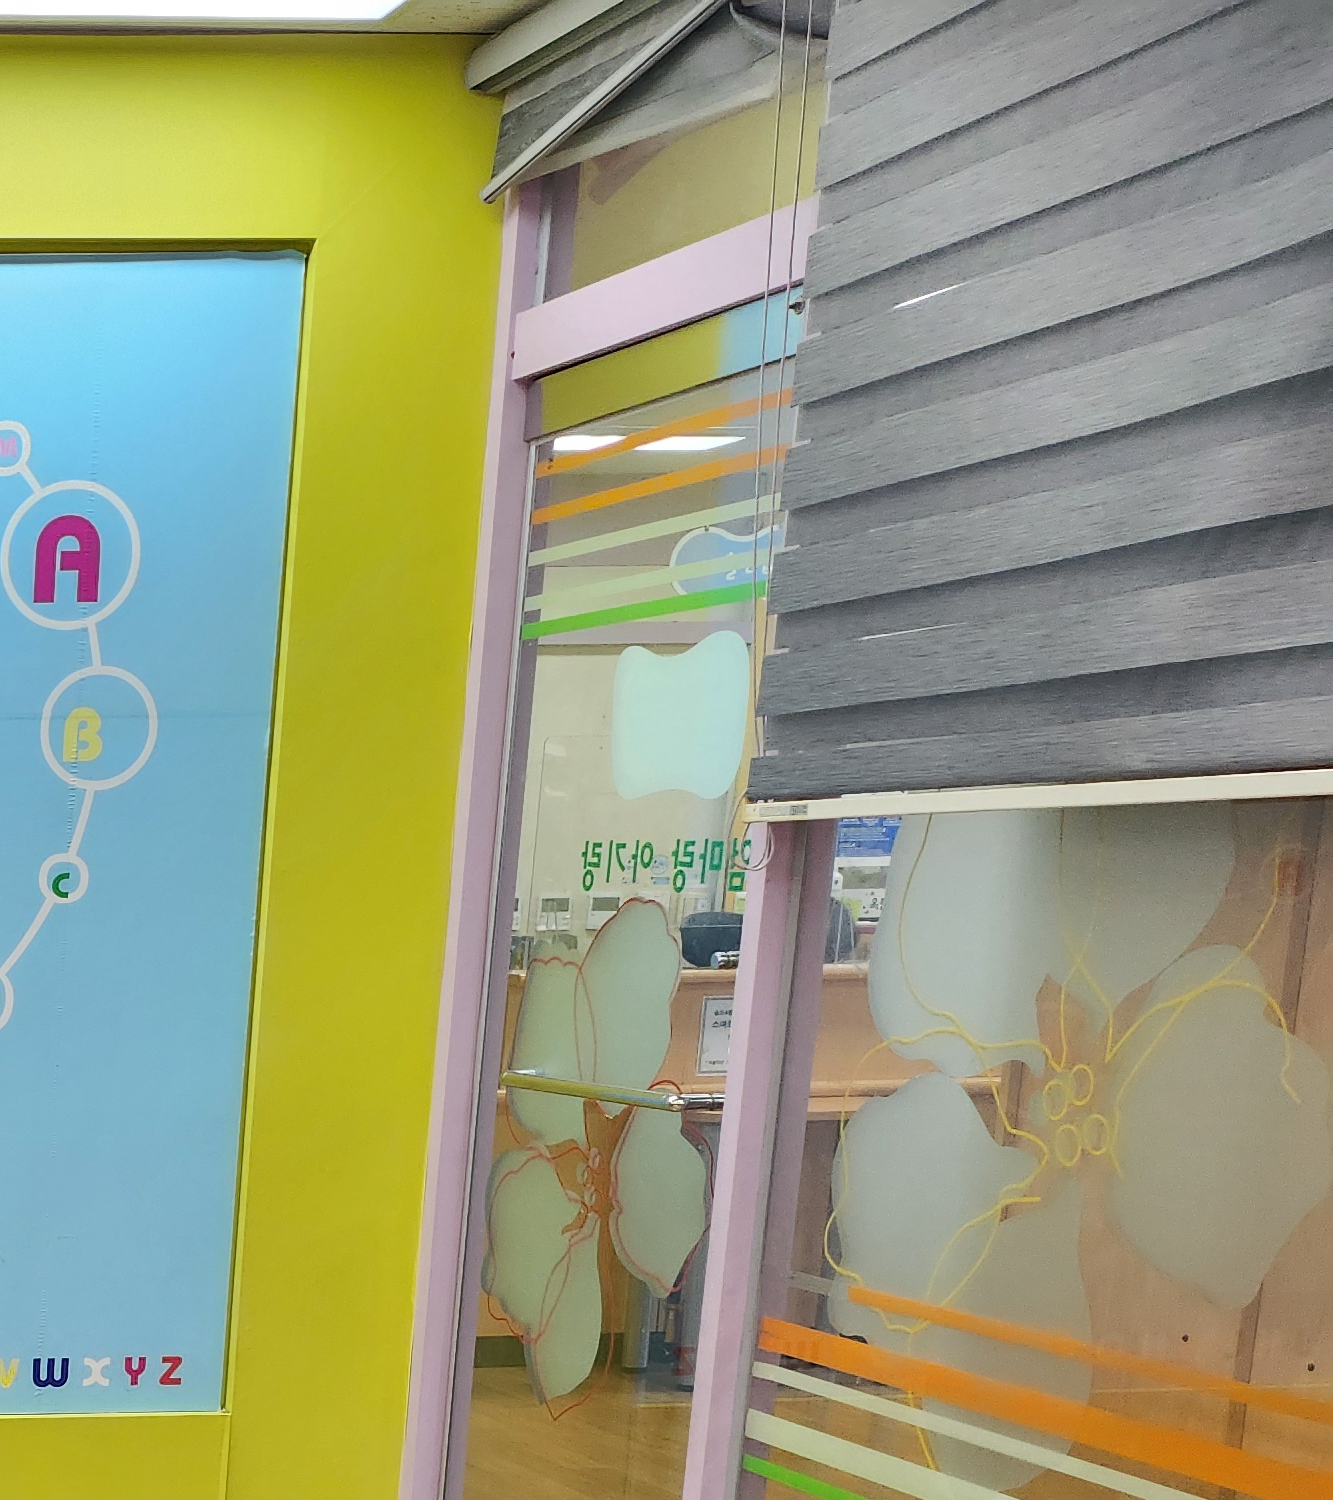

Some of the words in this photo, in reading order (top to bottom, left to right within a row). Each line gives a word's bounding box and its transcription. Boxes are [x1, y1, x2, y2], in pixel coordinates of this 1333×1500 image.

[33, 514, 100, 603] A
[63, 706, 103, 763] B
[52, 872, 70, 899] C
